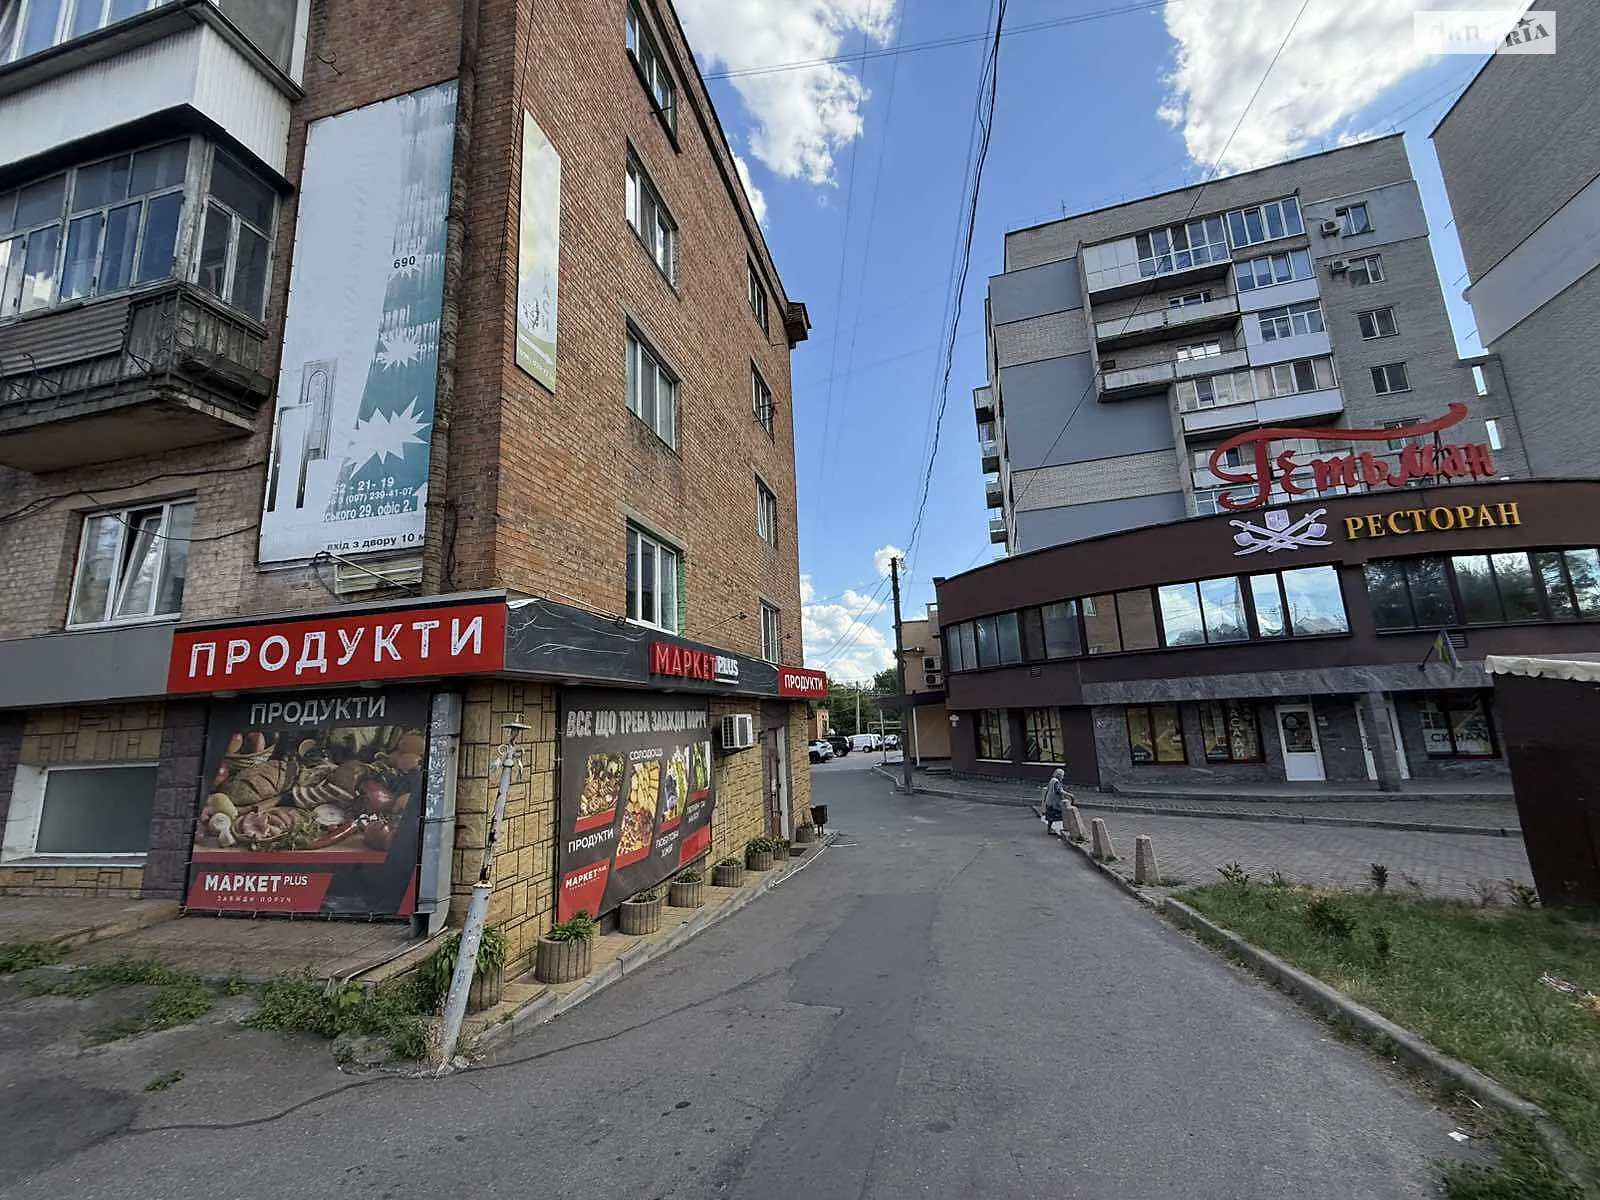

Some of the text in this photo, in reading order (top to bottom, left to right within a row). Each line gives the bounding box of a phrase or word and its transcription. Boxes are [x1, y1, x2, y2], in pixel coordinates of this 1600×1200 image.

[392, 255, 416, 269] 690
[377, 502, 401, 515] офіс
[1343, 502, 1522, 541] РЕСТОРАН
[362, 536, 397, 548] двору
[402, 533, 415, 542] 10
[188, 615, 483, 678] ПРОДУКТИ
[654, 642, 739, 682] МАРКЕТ PLUS
[784, 674, 823, 692] ПРОДУКТИ
[250, 695, 386, 726] ПРОДУКТИ
[566, 710, 592, 738] ВСЕ
[594, 710, 617, 738] ЩО
[619, 710, 650, 734] ТРЕБА
[567, 827, 614, 853] ПРОДУКТИ
[204, 874, 308, 893] МАРКЕТ PLUS
[565, 867, 599, 889] МАРКЕТ
